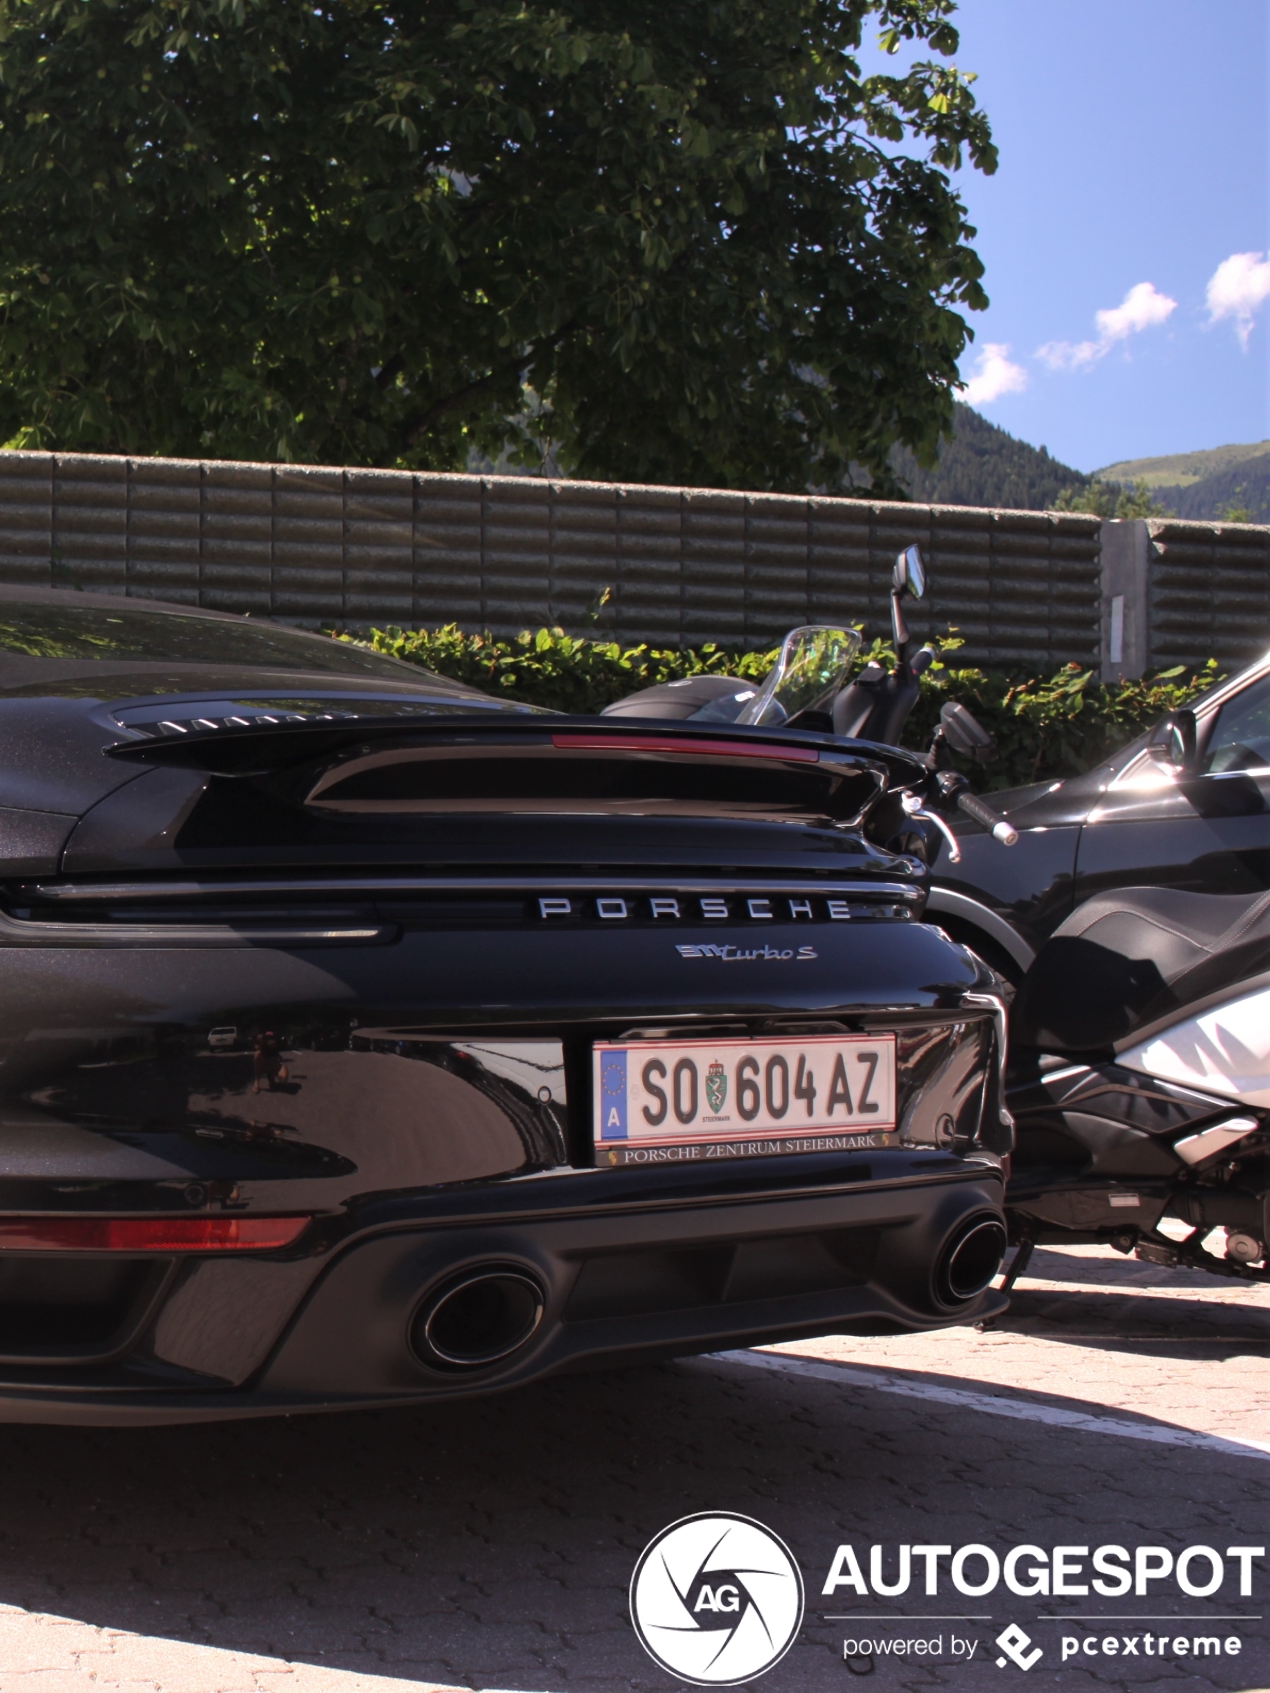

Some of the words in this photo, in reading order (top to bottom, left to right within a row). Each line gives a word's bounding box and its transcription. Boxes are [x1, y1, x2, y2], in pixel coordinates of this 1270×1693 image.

[538, 898, 852, 919] PORSCHE
[796, 946, 819, 960] S
[642, 1058, 699, 1127] SO
[607, 1107, 621, 1127] A
[702, 1115, 731, 1123] STEIERMARK
[624, 1146, 700, 1163] PORSCHE
[705, 1141, 781, 1158] ZENTRUM
[785, 1135, 876, 1153] STEIERMARK
